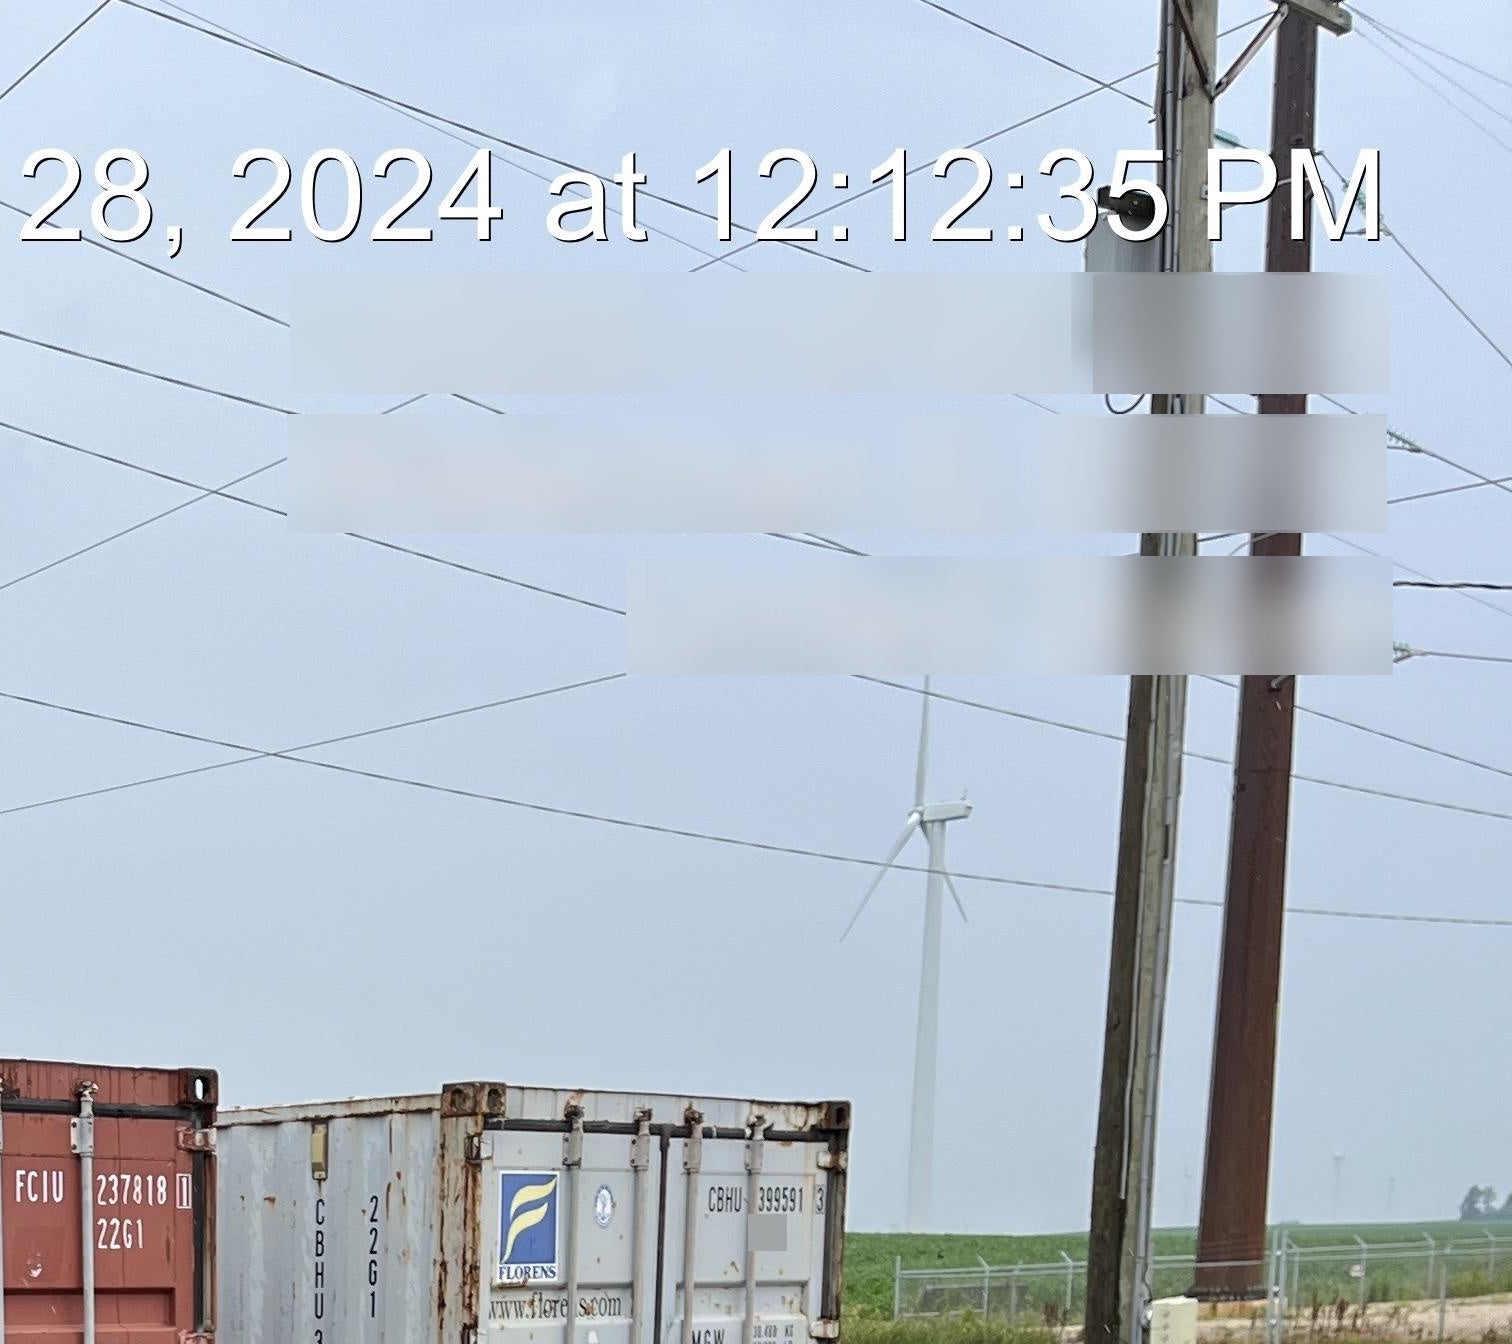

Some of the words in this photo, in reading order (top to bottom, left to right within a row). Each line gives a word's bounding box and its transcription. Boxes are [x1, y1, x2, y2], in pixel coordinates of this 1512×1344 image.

[15, 1169, 64, 1203] FCIU
[96, 1174, 167, 1207] 237818
[708, 1186, 743, 1213] CBHU
[758, 1186, 804, 1213] 399591
[96, 1217, 144, 1249] 22G1
[498, 1265, 557, 1280] FLORENS
